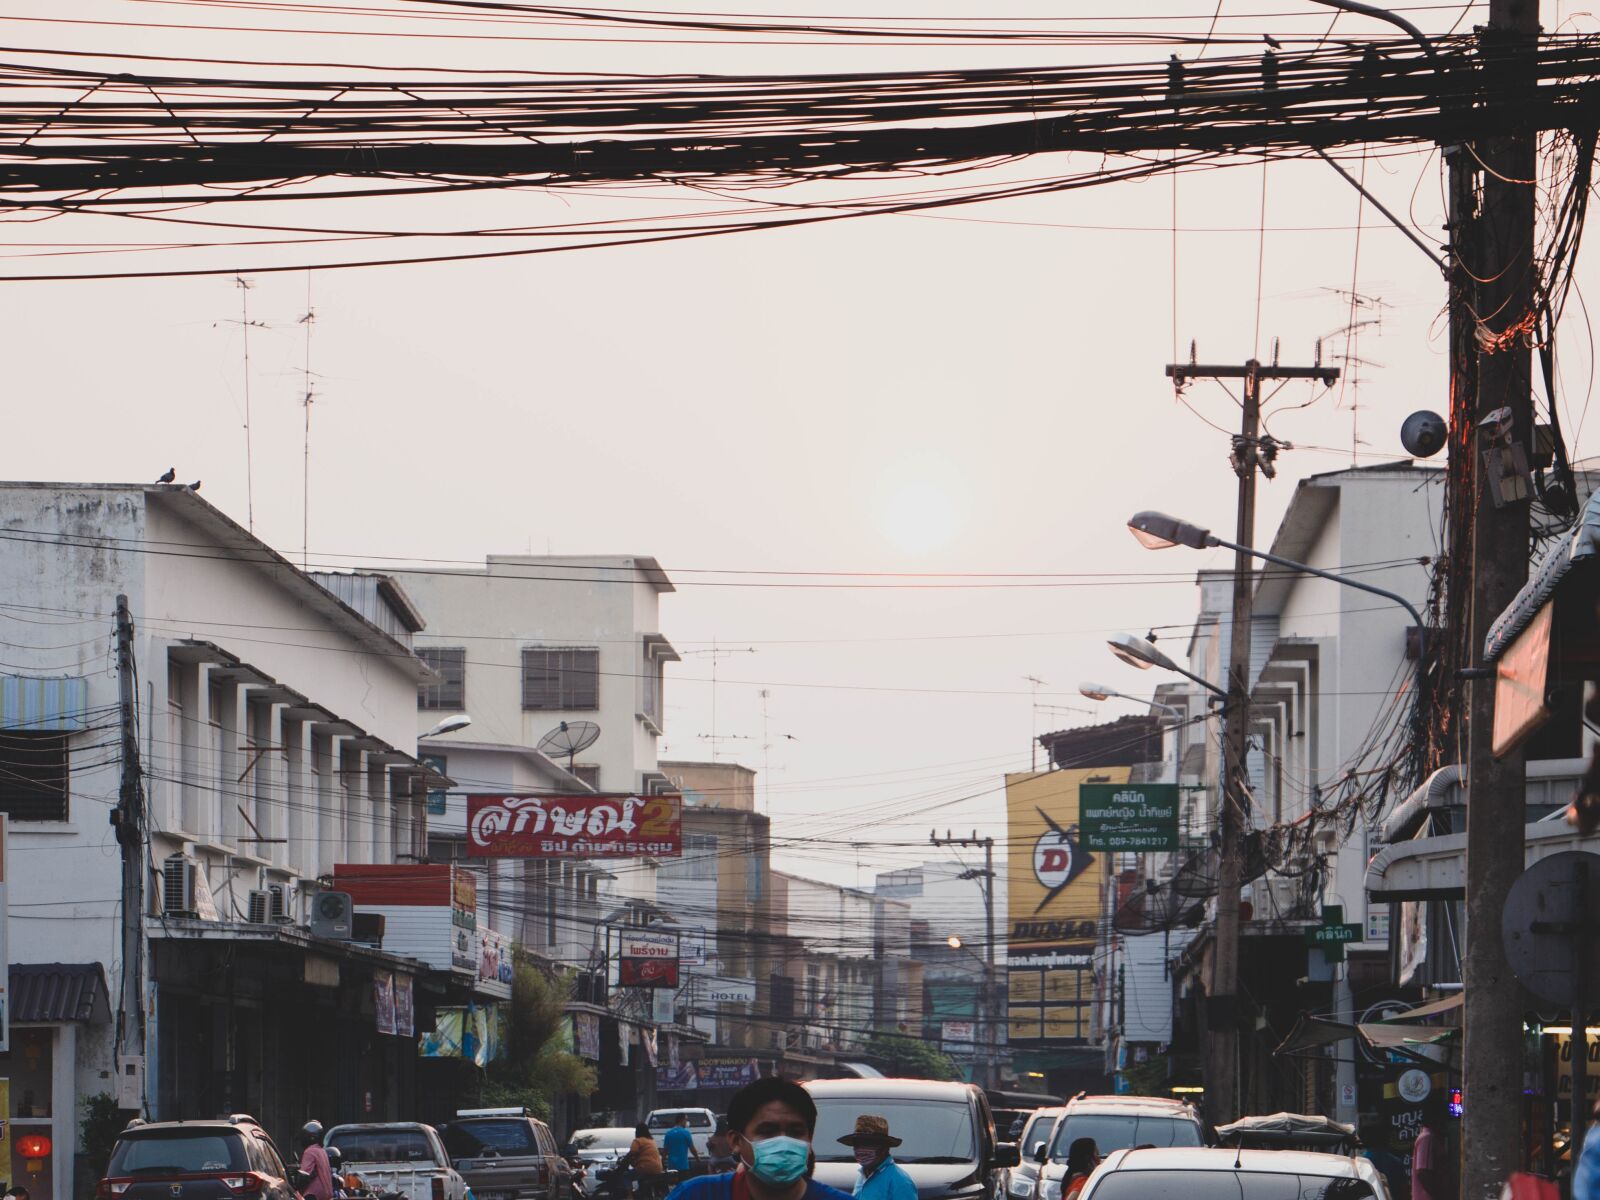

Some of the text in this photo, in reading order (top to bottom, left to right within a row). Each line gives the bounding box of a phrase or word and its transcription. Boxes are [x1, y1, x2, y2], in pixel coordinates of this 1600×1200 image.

[1112, 790, 1145, 803] คลินิก
[639, 799, 674, 836] 2
[1039, 848, 1069, 873] D
[1013, 921, 1097, 939] DUNLO
[1315, 926, 1353, 940] คลินิก
[711, 992, 750, 1001] HOTEL
